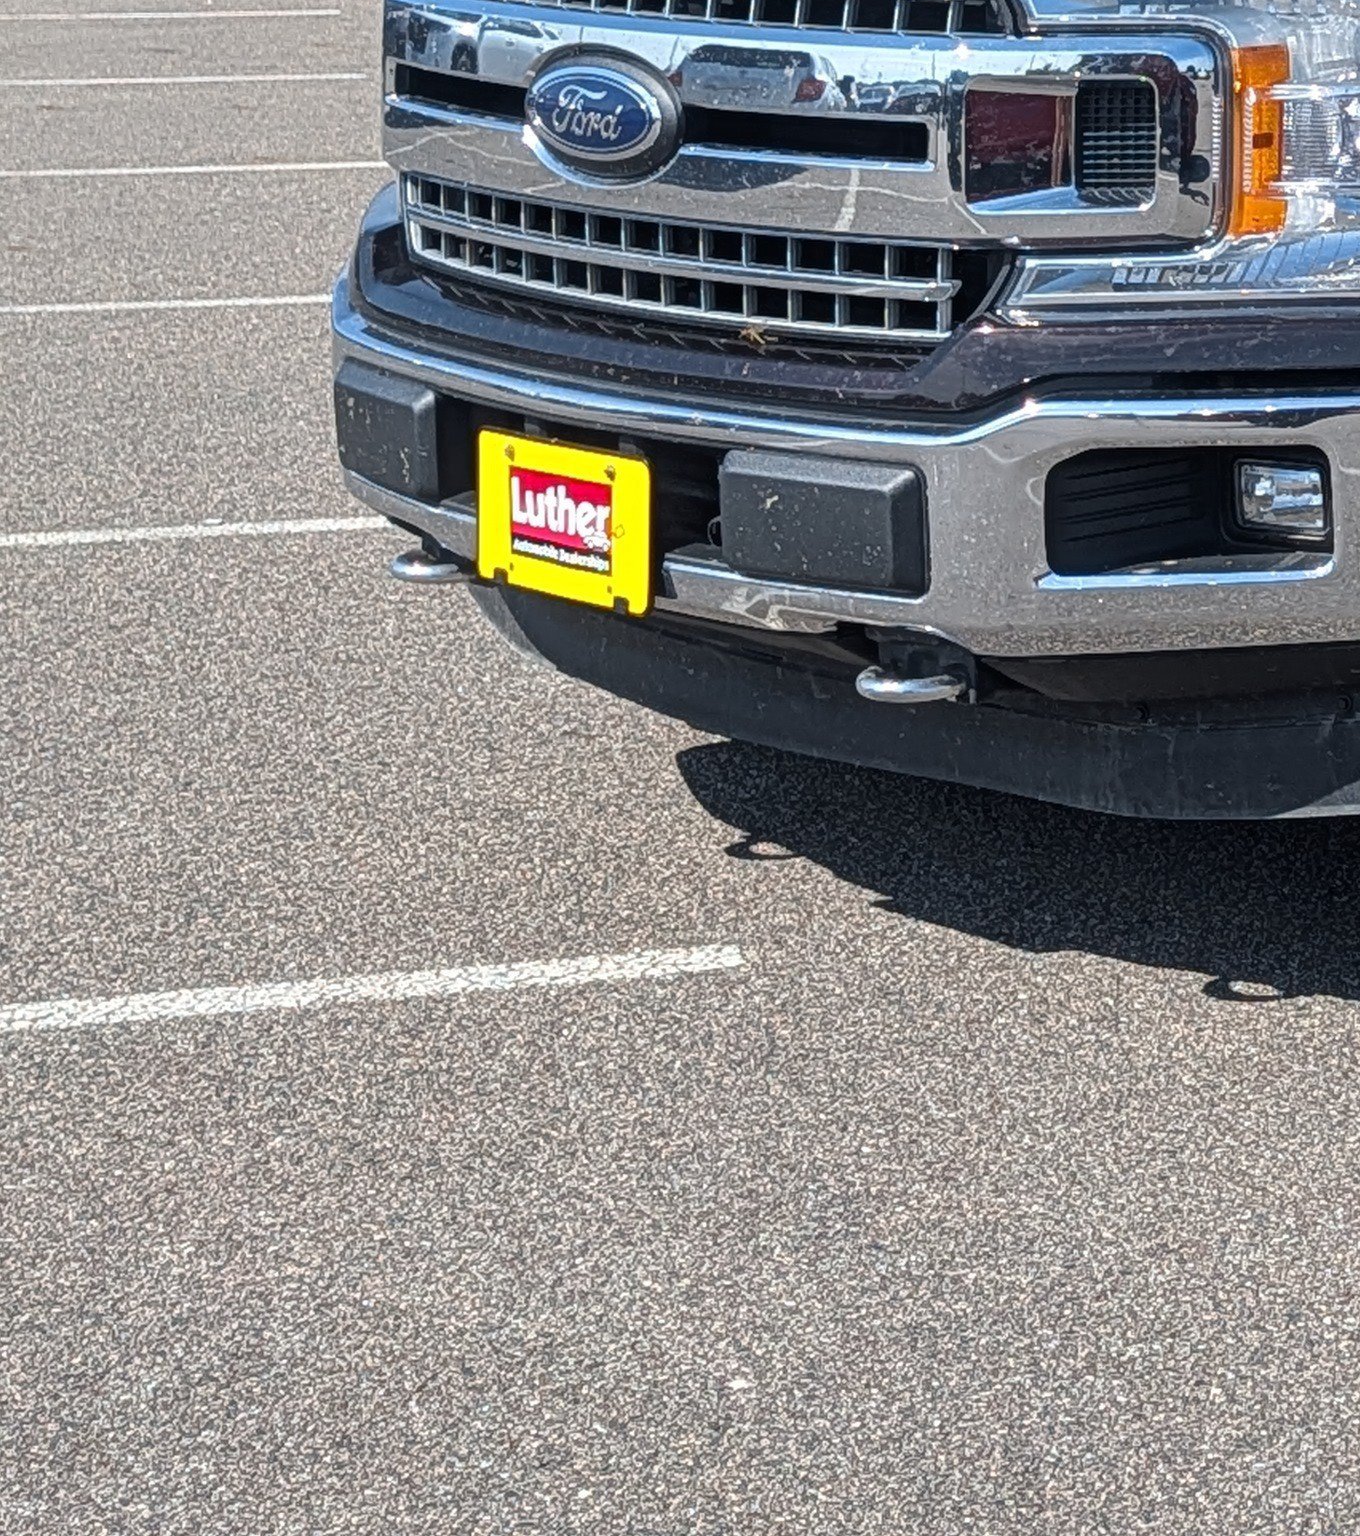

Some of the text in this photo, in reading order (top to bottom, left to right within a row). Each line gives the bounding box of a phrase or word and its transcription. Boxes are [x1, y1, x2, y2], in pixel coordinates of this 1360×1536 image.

[551, 84, 624, 142] Ford
[510, 475, 612, 537] Luther
[512, 537, 610, 571] Automobile Dealerships
